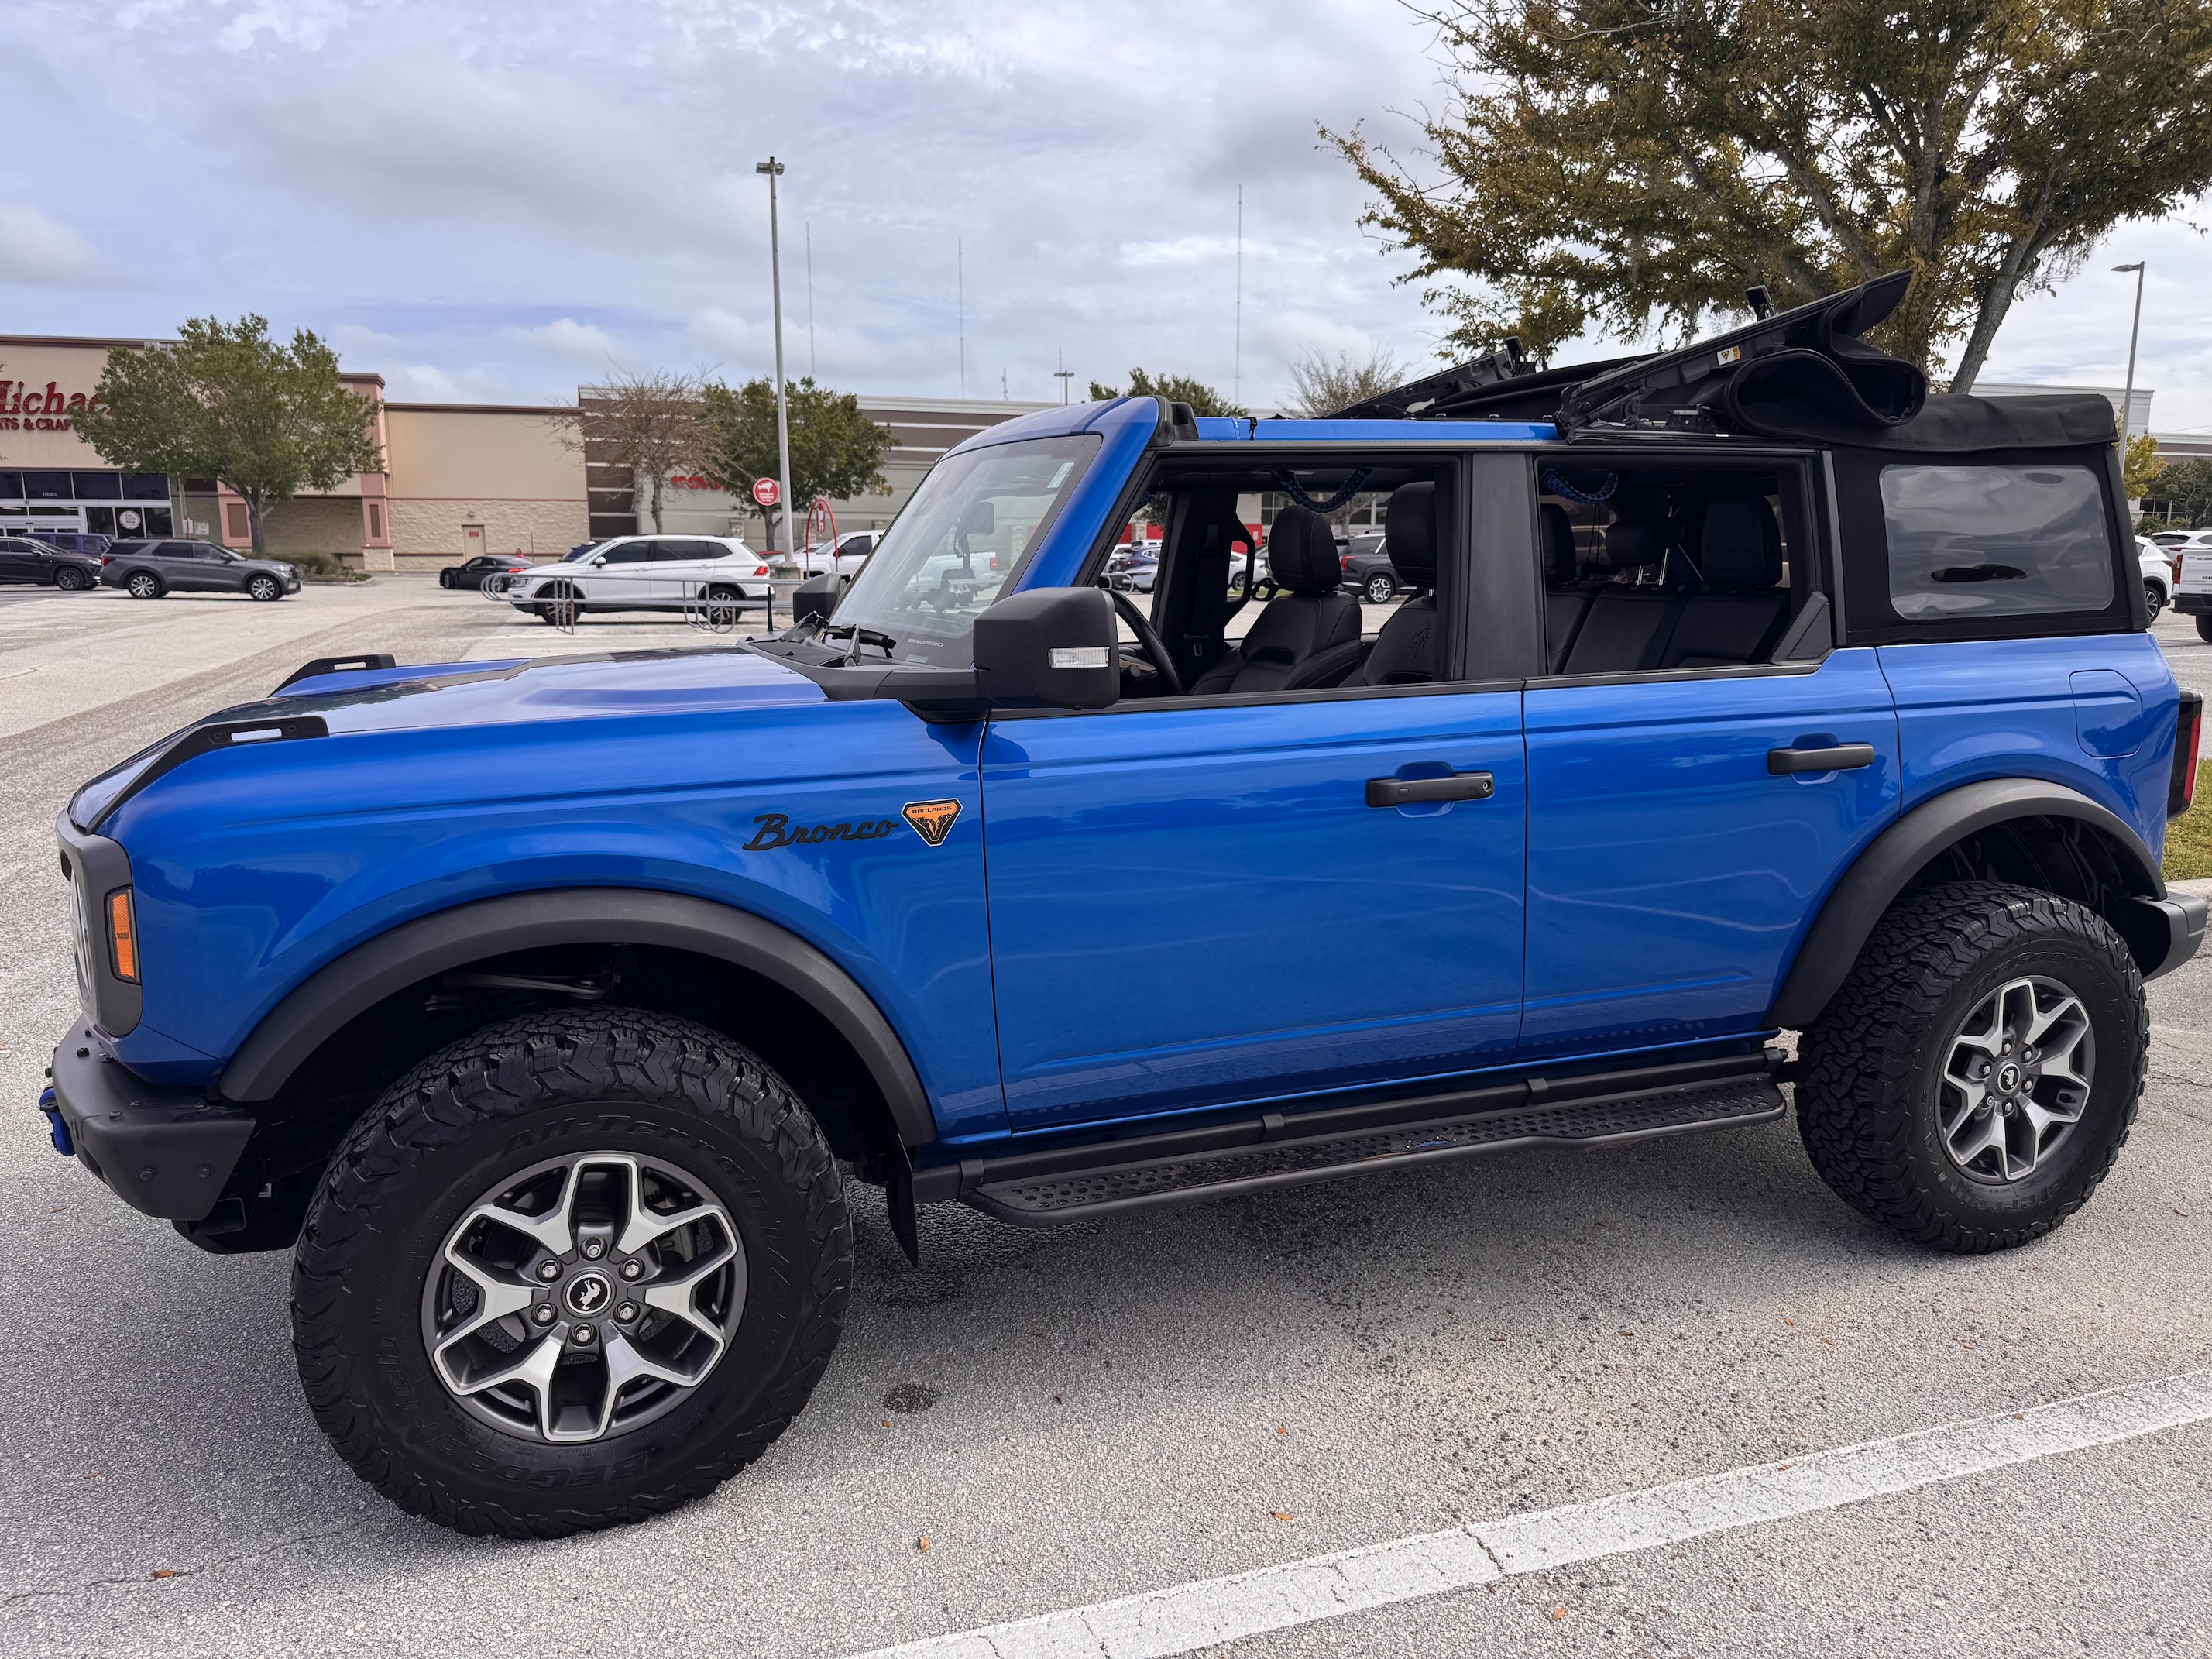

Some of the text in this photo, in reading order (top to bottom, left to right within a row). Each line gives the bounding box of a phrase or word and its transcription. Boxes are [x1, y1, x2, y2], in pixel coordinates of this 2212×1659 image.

[0, 380, 114, 415] ichae
[23, 418, 35, 430] &
[908, 638, 945, 647] BRONCO
[742, 813, 900, 851] Bronco
[500, 1115, 768, 1214] All-Terrain
[376, 1337, 648, 1491] BFGoodrich
